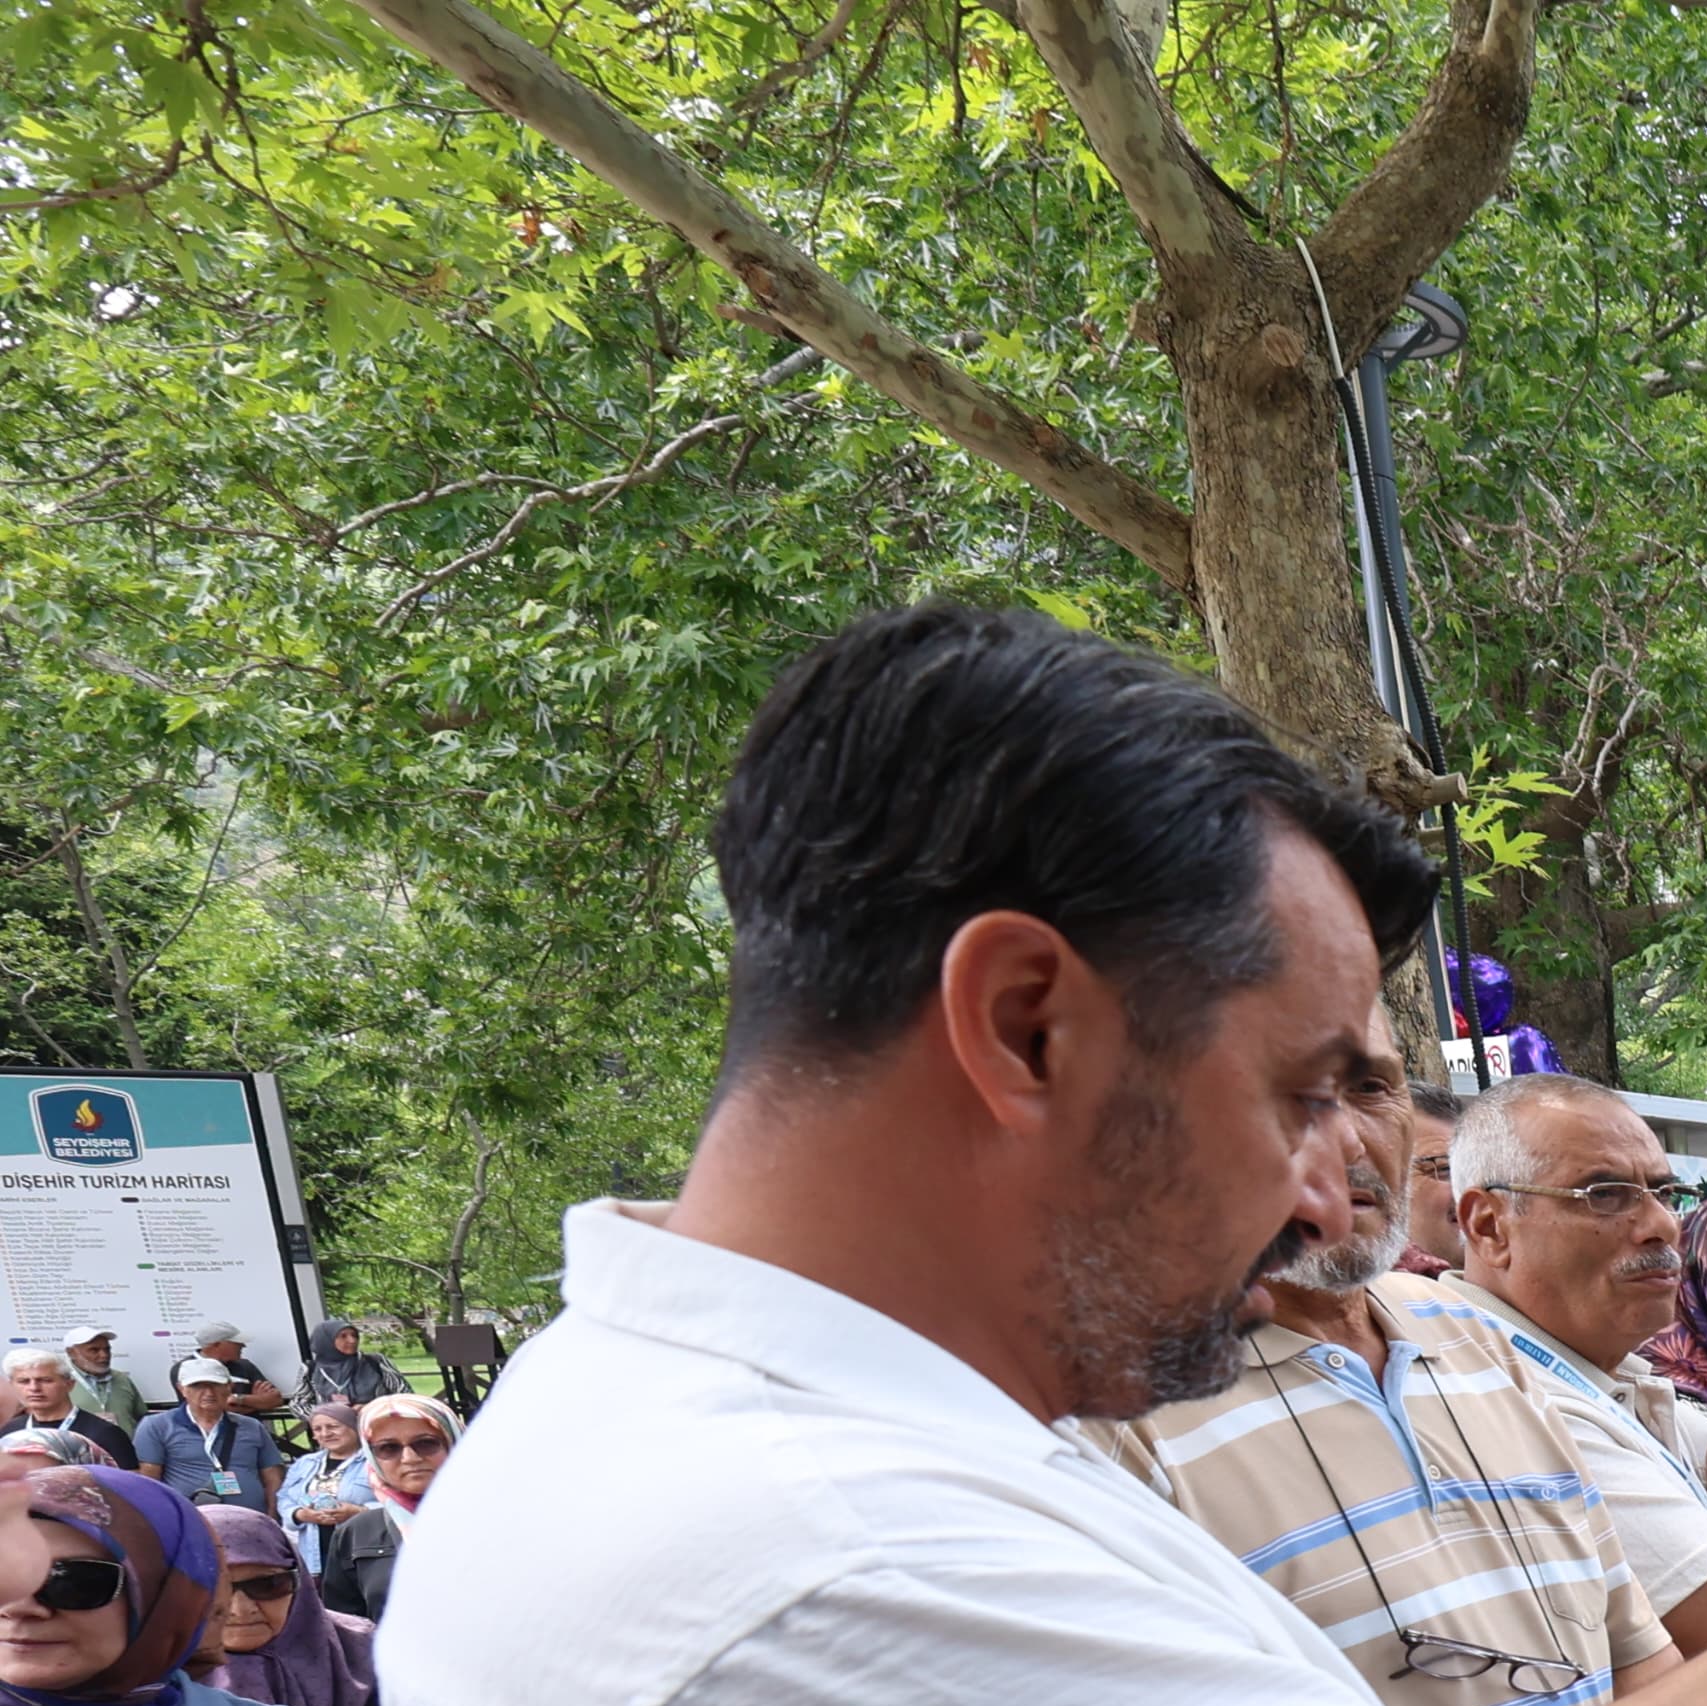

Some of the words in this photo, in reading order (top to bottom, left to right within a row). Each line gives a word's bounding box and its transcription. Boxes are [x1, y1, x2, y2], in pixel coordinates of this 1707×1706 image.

[53, 1136, 130, 1148] SEYDİŞEHİR
[56, 1147, 134, 1157] BELEDİYESİ
[0, 1172, 75, 1191] DİŞEHİR
[79, 1172, 147, 1189] TURİZM
[151, 1172, 231, 1189] HARİTASI
